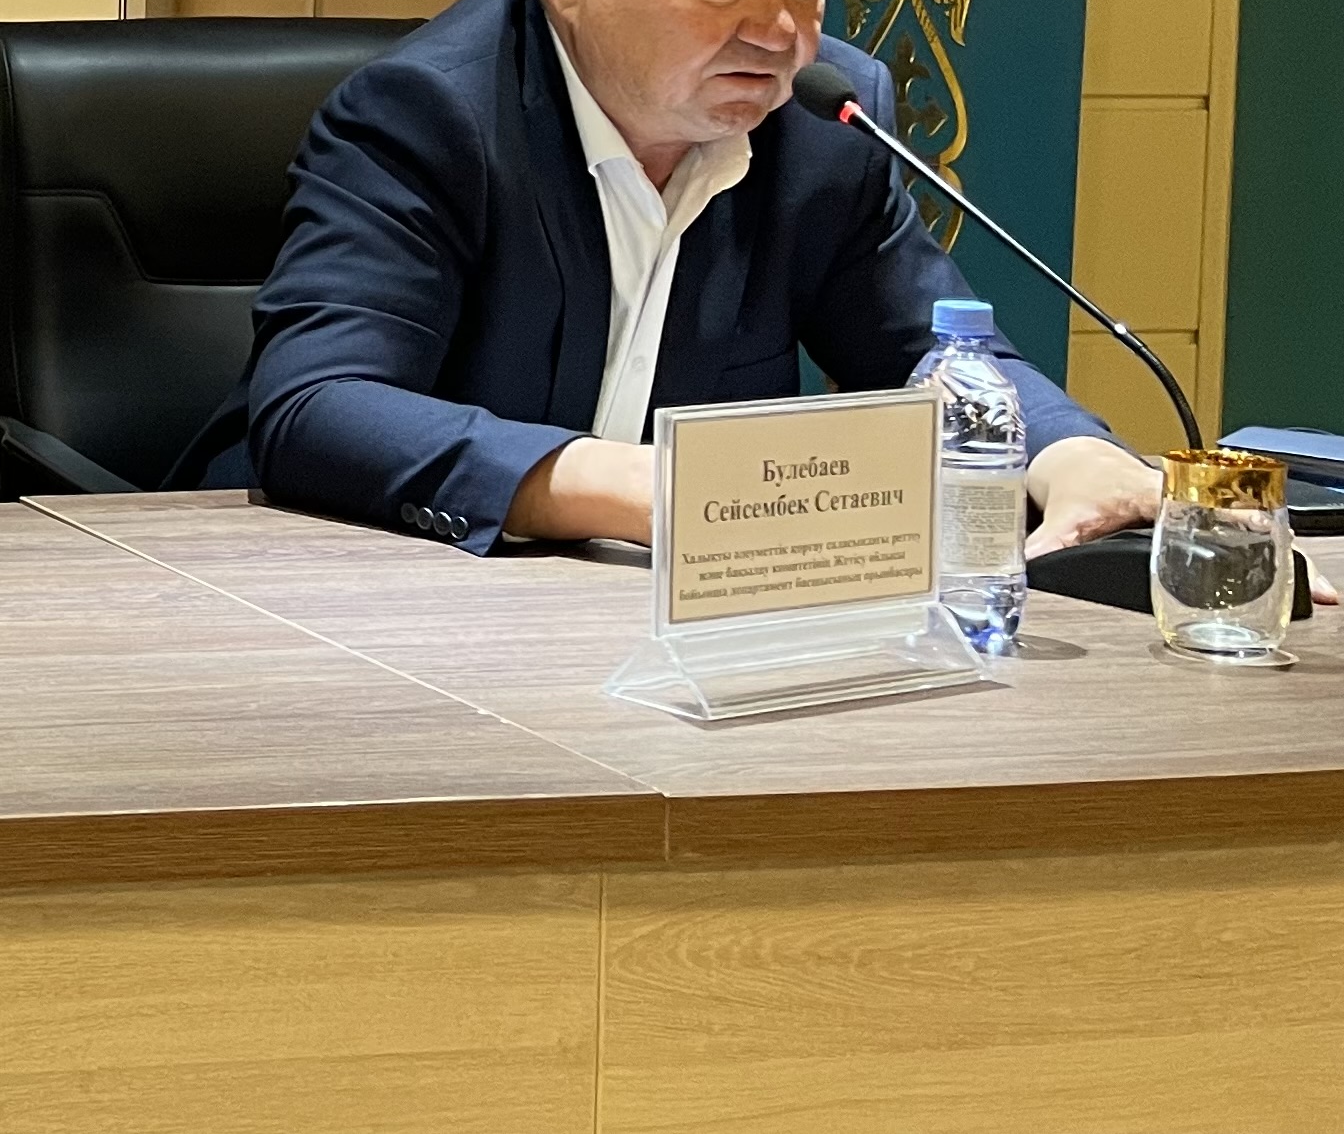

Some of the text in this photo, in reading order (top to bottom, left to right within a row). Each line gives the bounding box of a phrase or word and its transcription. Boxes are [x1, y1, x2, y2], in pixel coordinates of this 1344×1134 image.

[762, 455, 851, 488] Булебаев
[703, 486, 905, 524] Сейсембек Сетаевич
